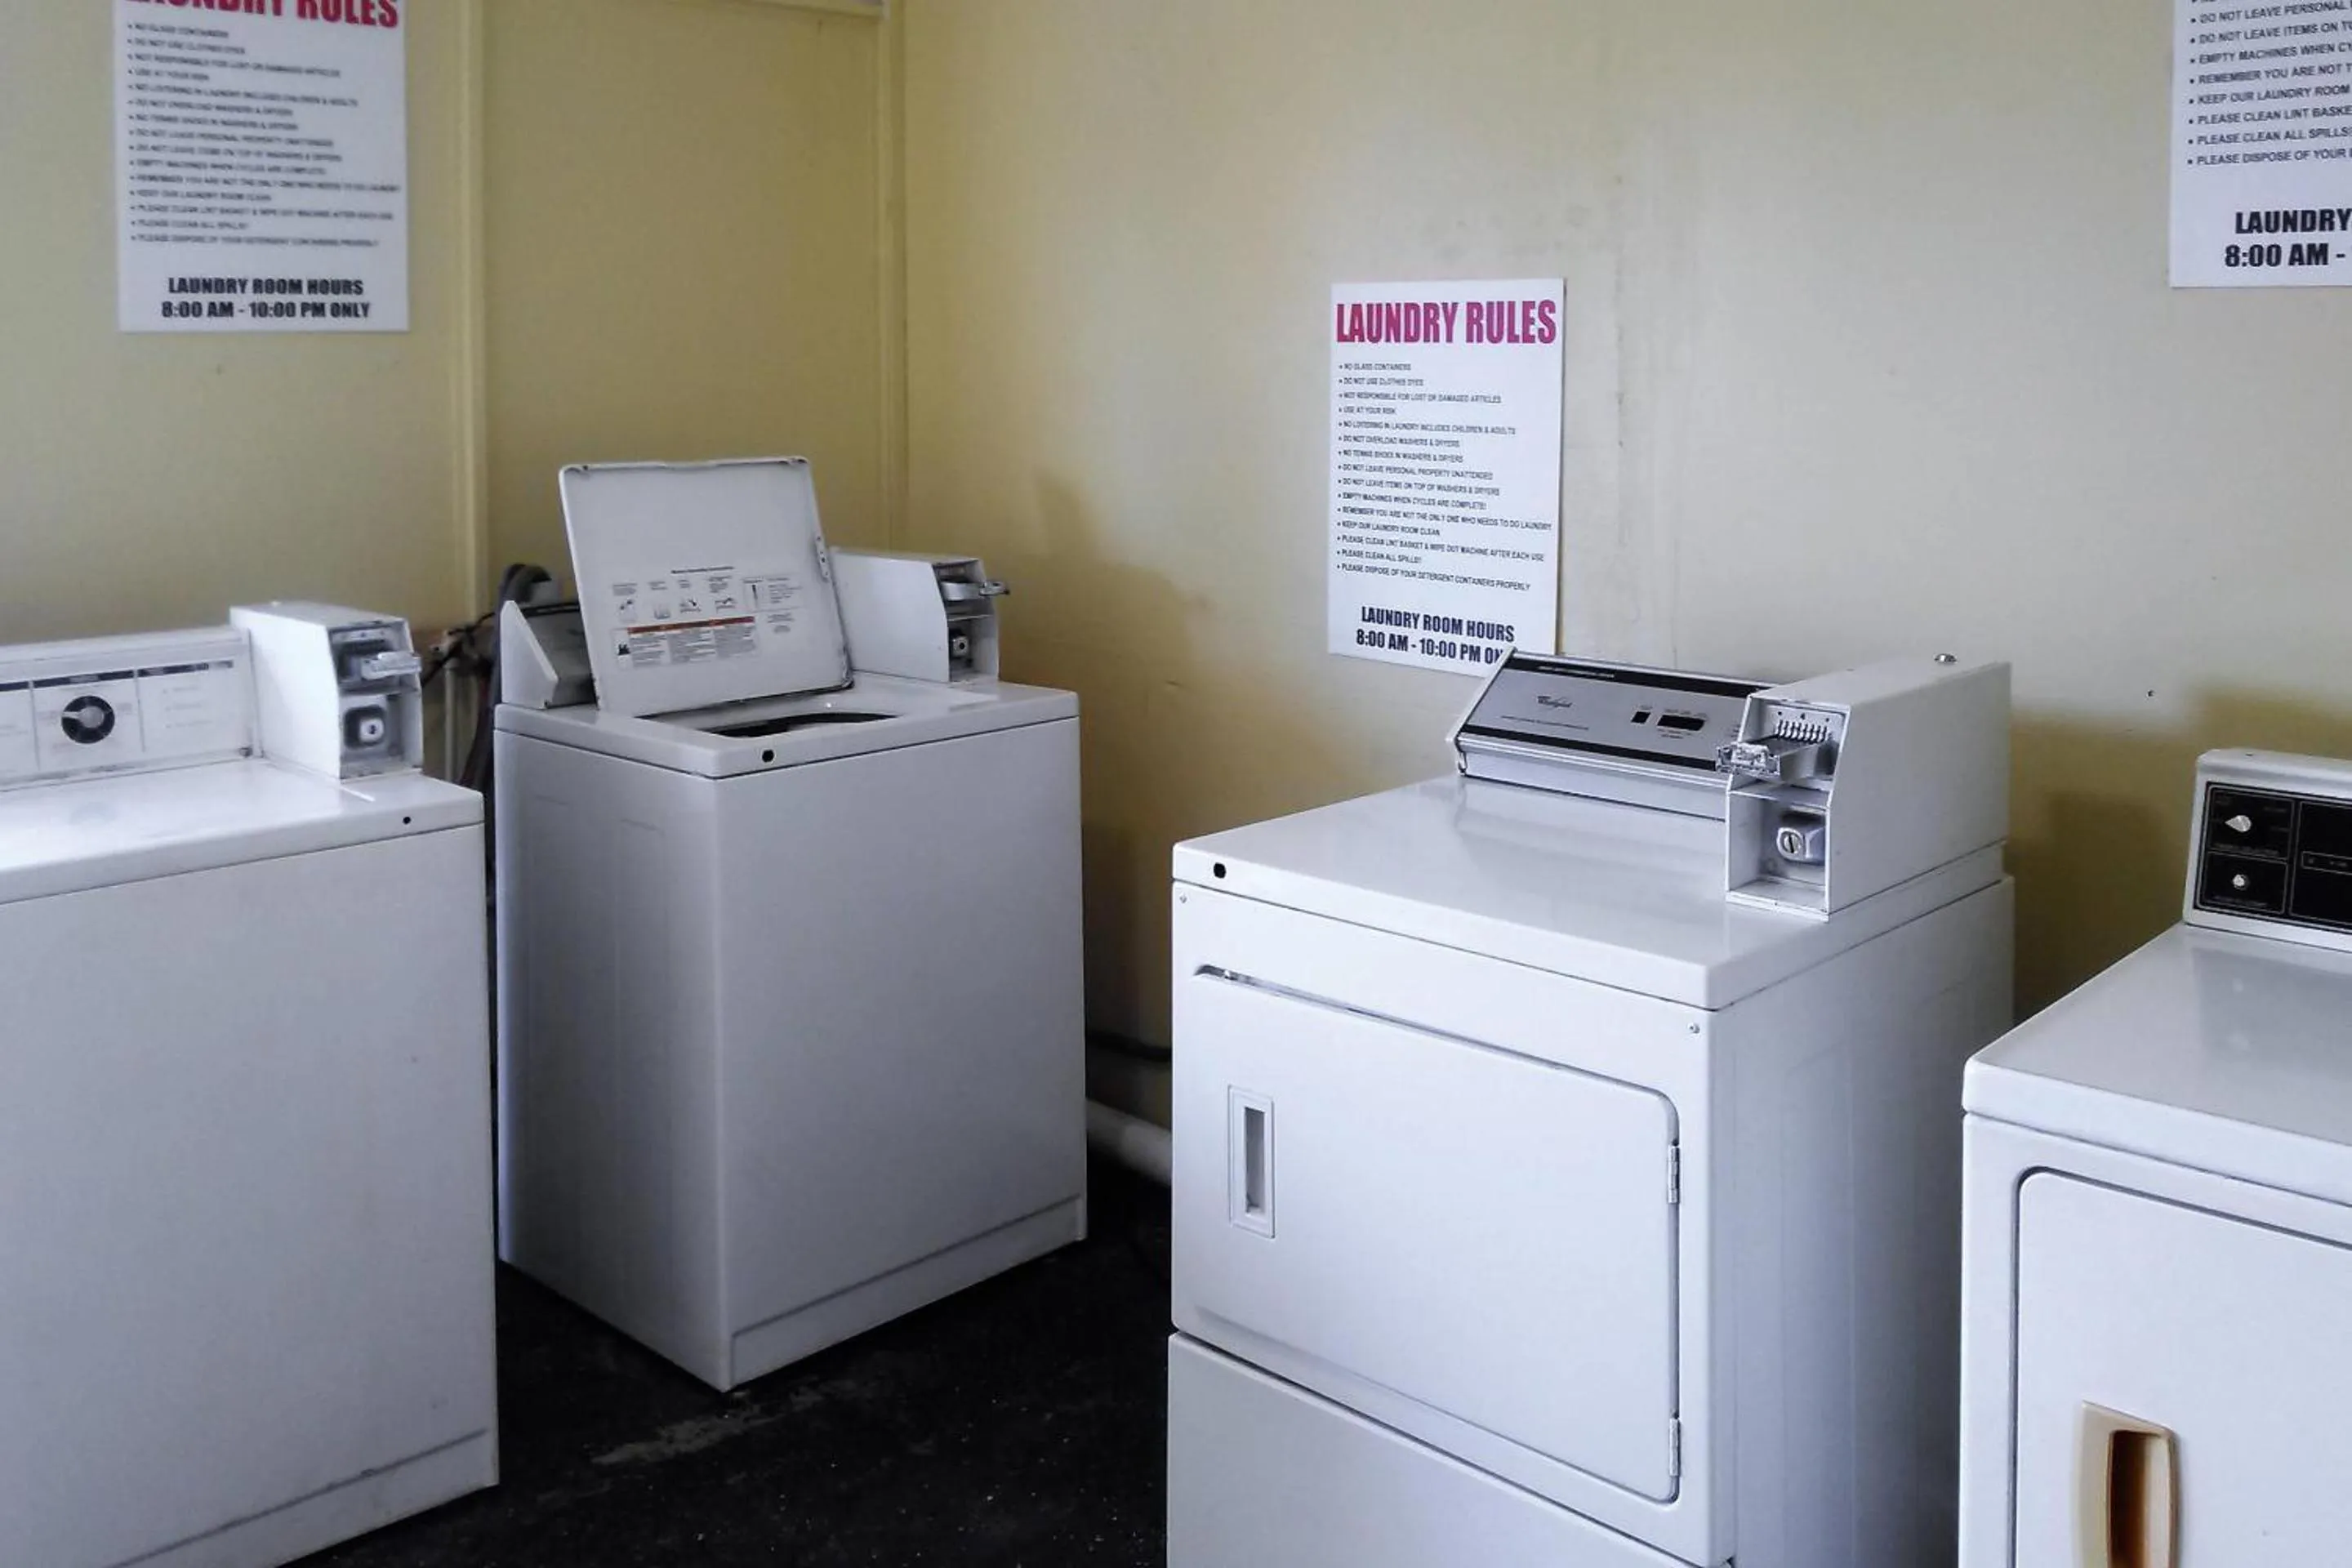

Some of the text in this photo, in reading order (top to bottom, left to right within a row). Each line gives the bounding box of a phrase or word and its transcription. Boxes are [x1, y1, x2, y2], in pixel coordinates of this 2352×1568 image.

[2199, 0, 2347, 24] DO NOT LEAVE PERSONAL
[2199, 33, 2215, 44] DO
[2218, 31, 2242, 42] NOT
[2243, 27, 2280, 40] LEAVE
[2283, 24, 2318, 36] ITEMS
[2320, 22, 2337, 33] ON
[2198, 51, 2234, 64] EMPTY
[2238, 47, 2296, 60] MACHINES
[2300, 43, 2334, 56] WHEN
[2198, 70, 2261, 84] REMEMBER
[2264, 68, 2288, 79] YOU
[2292, 65, 2315, 77] ARE
[2318, 64, 2341, 74] NOT
[2198, 84, 2350, 105] KEEP OUR LAUNDRY ROOM
[2198, 113, 2240, 125] PLEASE
[2243, 110, 2281, 122] CLEAN
[2283, 108, 2309, 119] LINT
[2197, 133, 2240, 145] PLEASE
[2243, 131, 2280, 142] CLEAN
[2283, 129, 2306, 140] ALL
[2197, 148, 2345, 165] PLEASE DISPOSE OF YOUR
[2235, 208, 2352, 234] LAUNDRY
[2225, 244, 2282, 267] 8:00
[2287, 243, 2328, 265] AM
[168, 278, 363, 295] LAUNDRY ROOM HOURS
[162, 301, 203, 318] 8:00
[207, 301, 234, 317] AM
[248, 301, 296, 318] 10:00
[301, 302, 326, 317] PM
[330, 302, 370, 318] ONLY
[1336, 299, 1557, 344] LAUNDRY RULES
[1361, 606, 1515, 643] LAUNDRY ROOM HOURS
[1356, 628, 1385, 648] 8:00
[1388, 633, 1409, 652] AM
[1419, 638, 1456, 659] 10:00
[1459, 644, 1481, 664] PM
